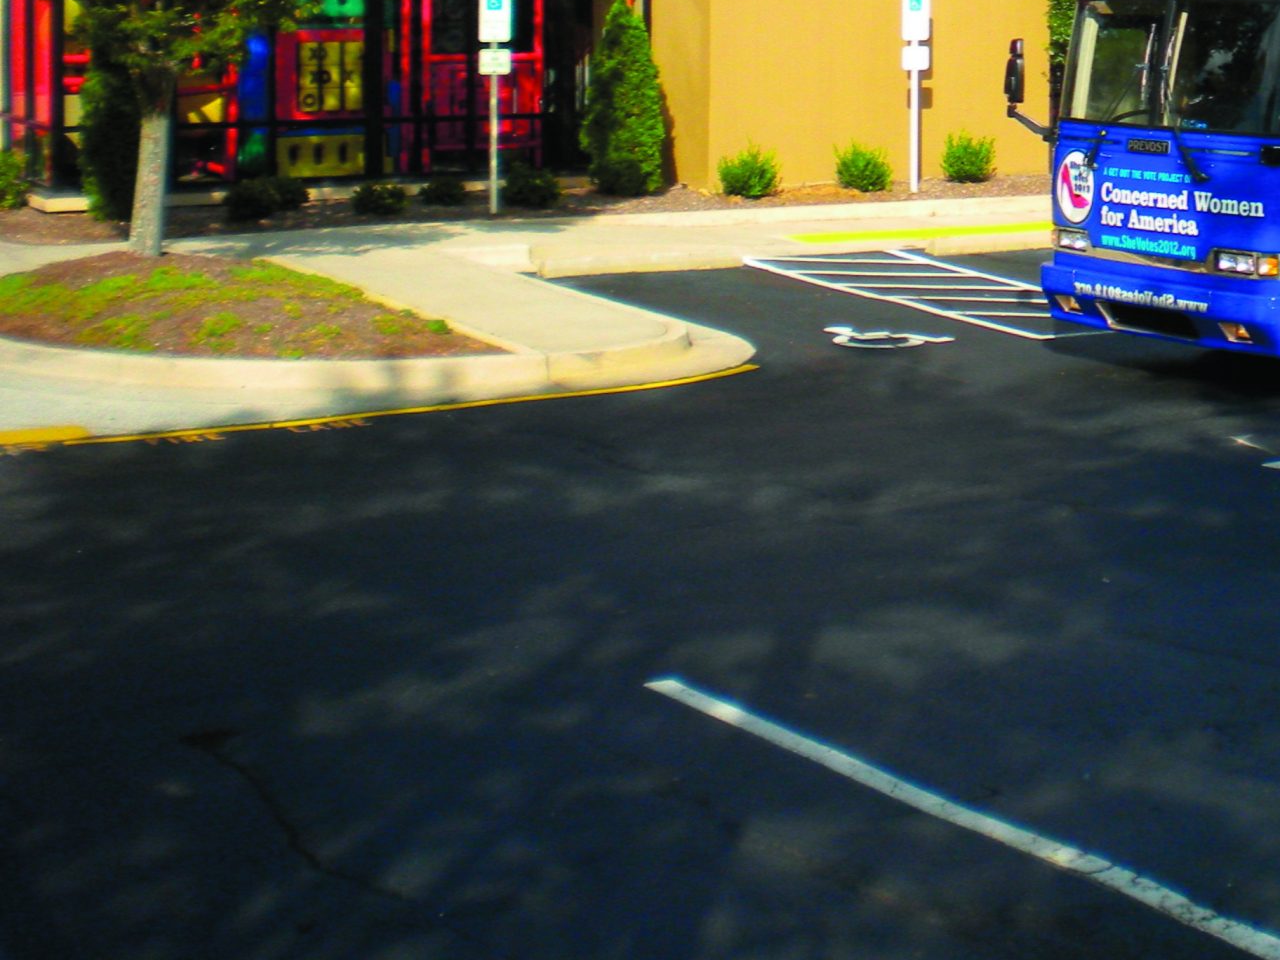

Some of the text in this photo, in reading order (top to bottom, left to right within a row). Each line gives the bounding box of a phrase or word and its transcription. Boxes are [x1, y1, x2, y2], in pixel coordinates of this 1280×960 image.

[1128, 139, 1169, 153] PREVOST
[1108, 167, 1119, 177] GET
[1119, 168, 1130, 178] OUT
[1131, 169, 1142, 179] THE
[1143, 170, 1157, 181] VOTE
[1158, 172, 1183, 183] PROJECT
[1101, 181, 1265, 217] Concerned Women
[1101, 205, 1199, 236] for America
[1101, 234, 1197, 260] www.SheVotes2012.org
